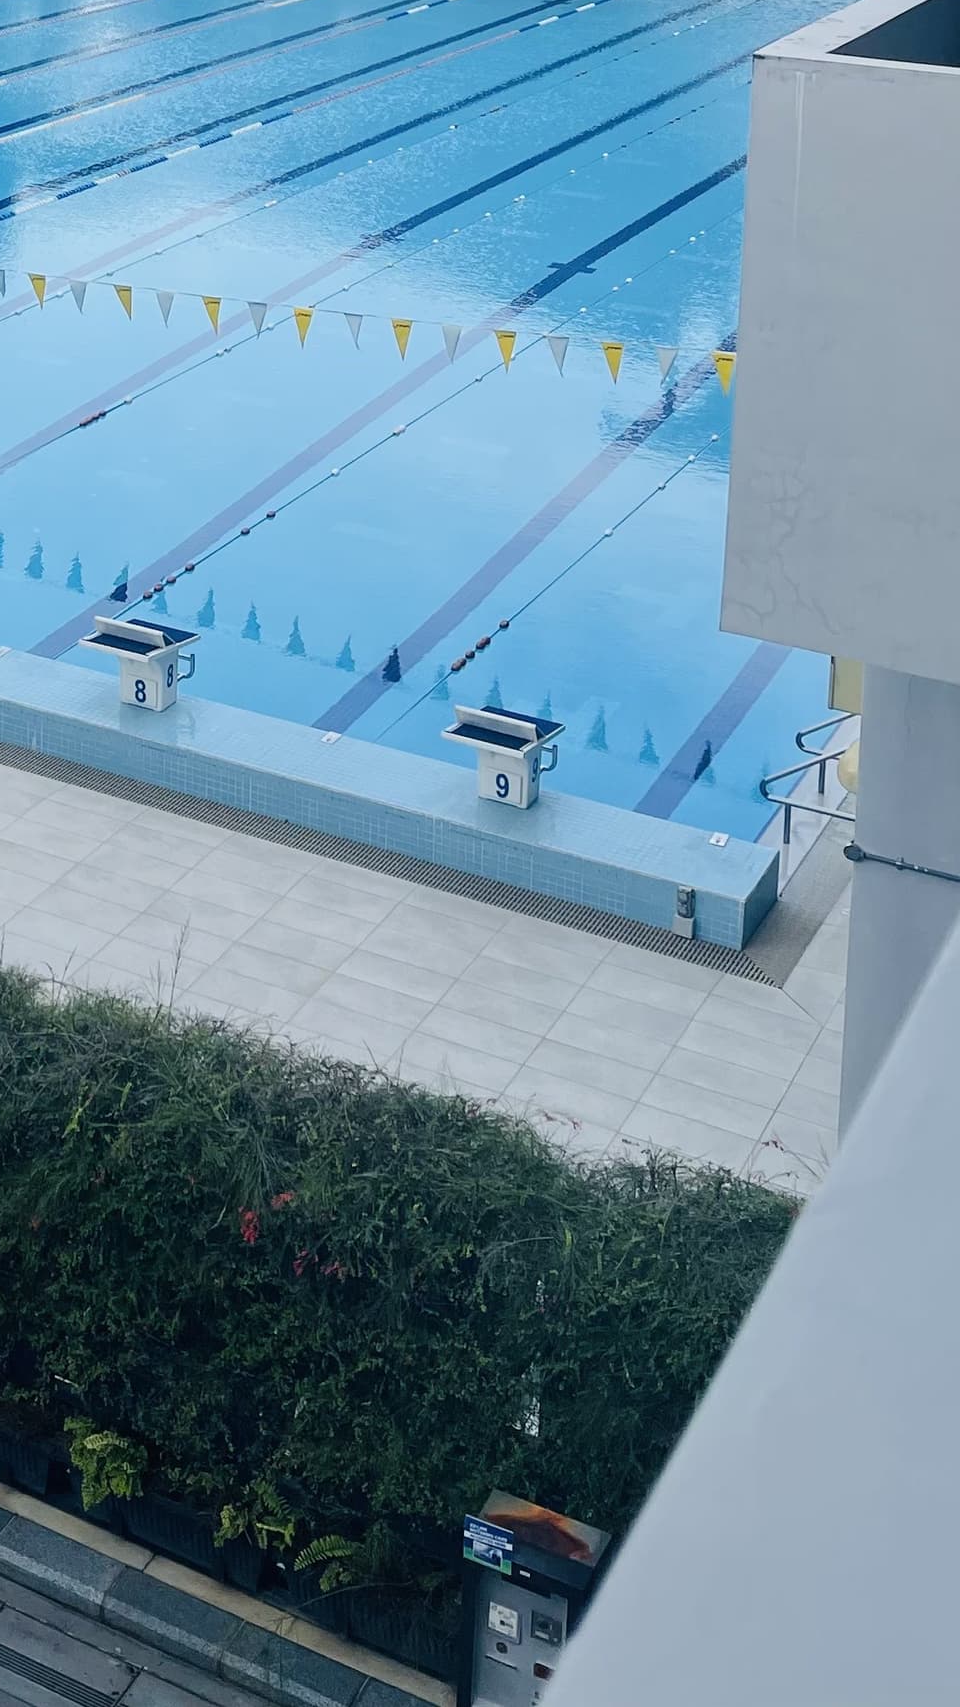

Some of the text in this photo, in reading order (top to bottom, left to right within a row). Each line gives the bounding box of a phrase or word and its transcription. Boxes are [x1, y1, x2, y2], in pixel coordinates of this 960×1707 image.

[166, 663, 174, 688] 8
[134, 679, 146, 703] 8
[531, 757, 539, 783] 9
[495, 773, 510, 798] 9
